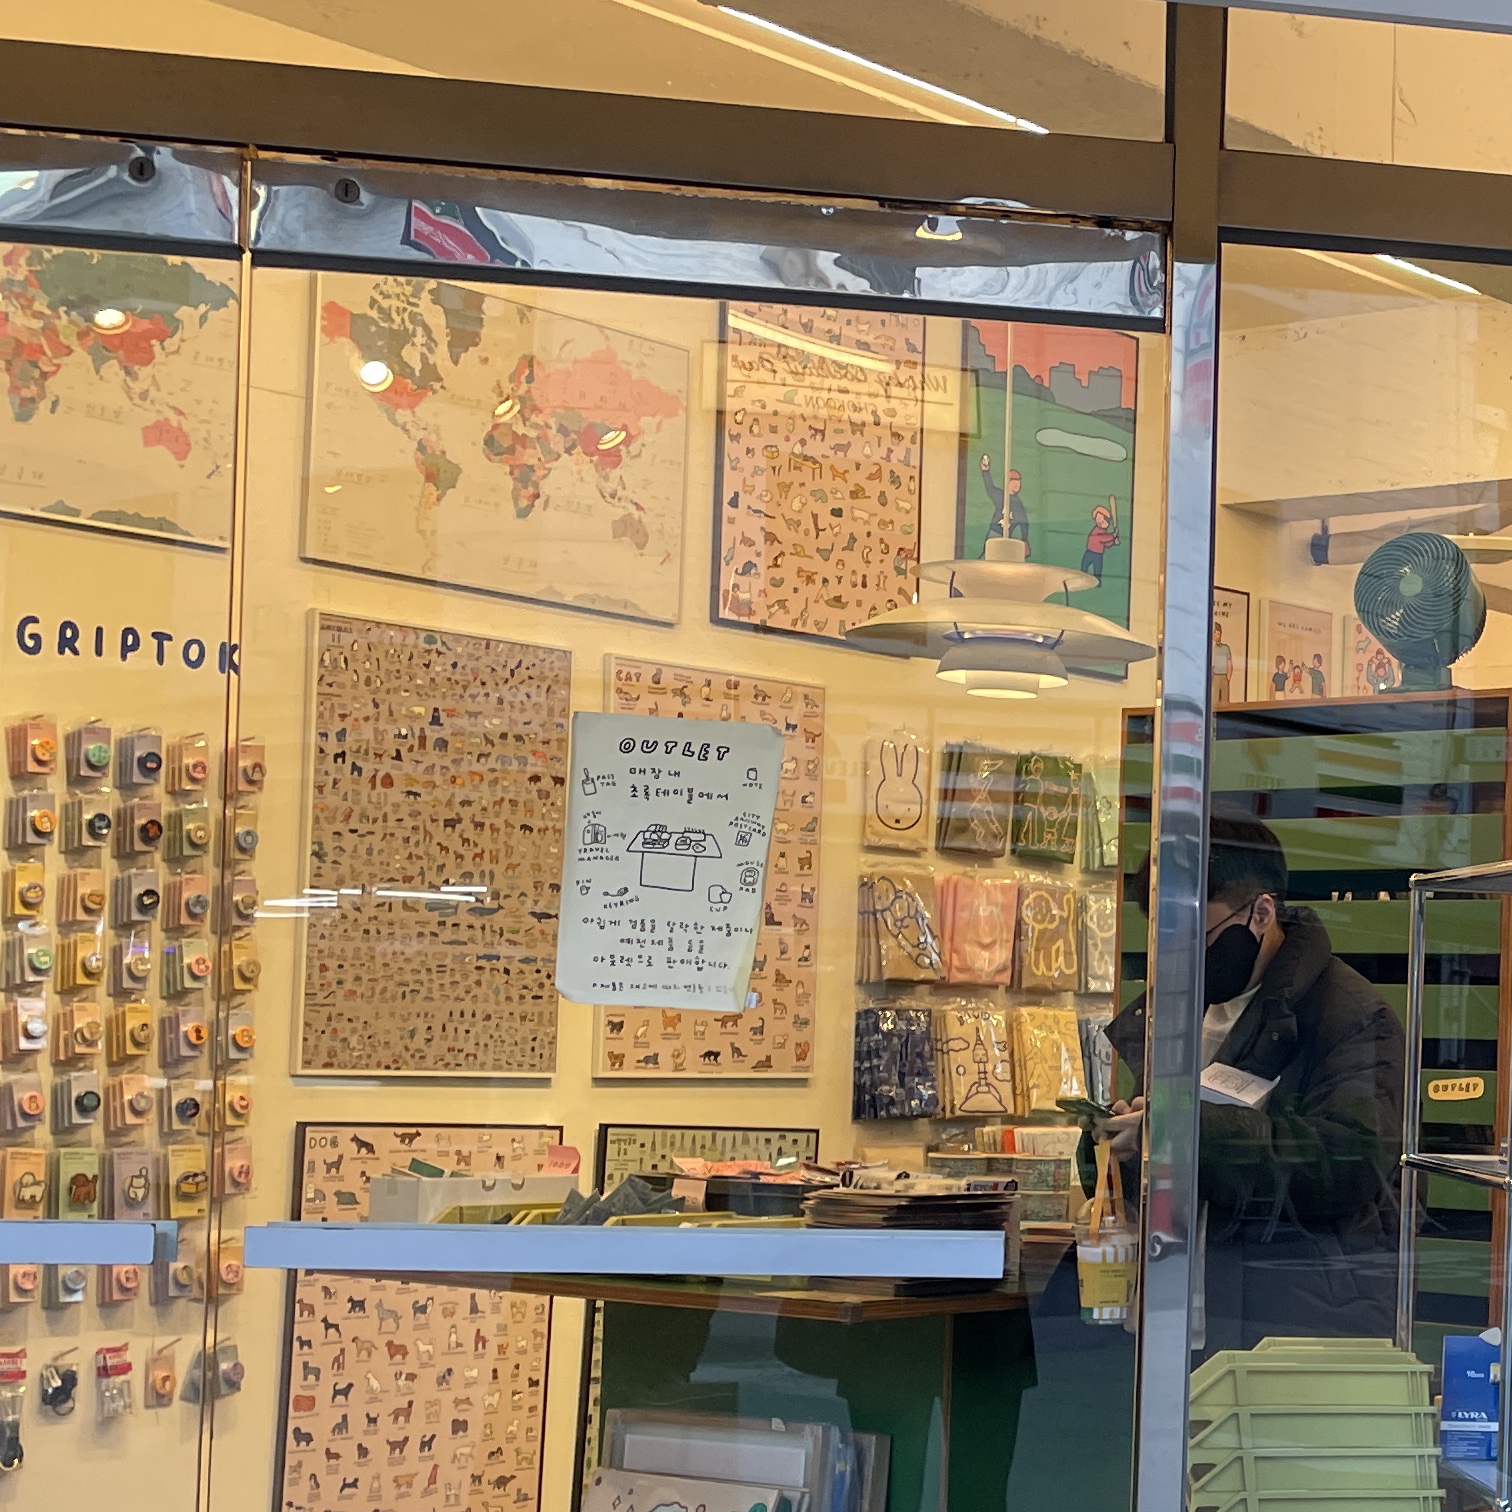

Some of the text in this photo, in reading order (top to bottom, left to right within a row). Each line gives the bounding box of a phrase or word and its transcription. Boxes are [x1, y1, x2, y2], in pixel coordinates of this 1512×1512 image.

[16, 615, 240, 676] GRIPTOK
[615, 669, 642, 683] CAT
[619, 737, 730, 761] OUTLET
[709, 905, 728, 913] CUP
[1432, 1082, 1479, 1094] OUTLET
[308, 1135, 339, 1149] DOG
[1457, 1411, 1488, 1420] LYRA
